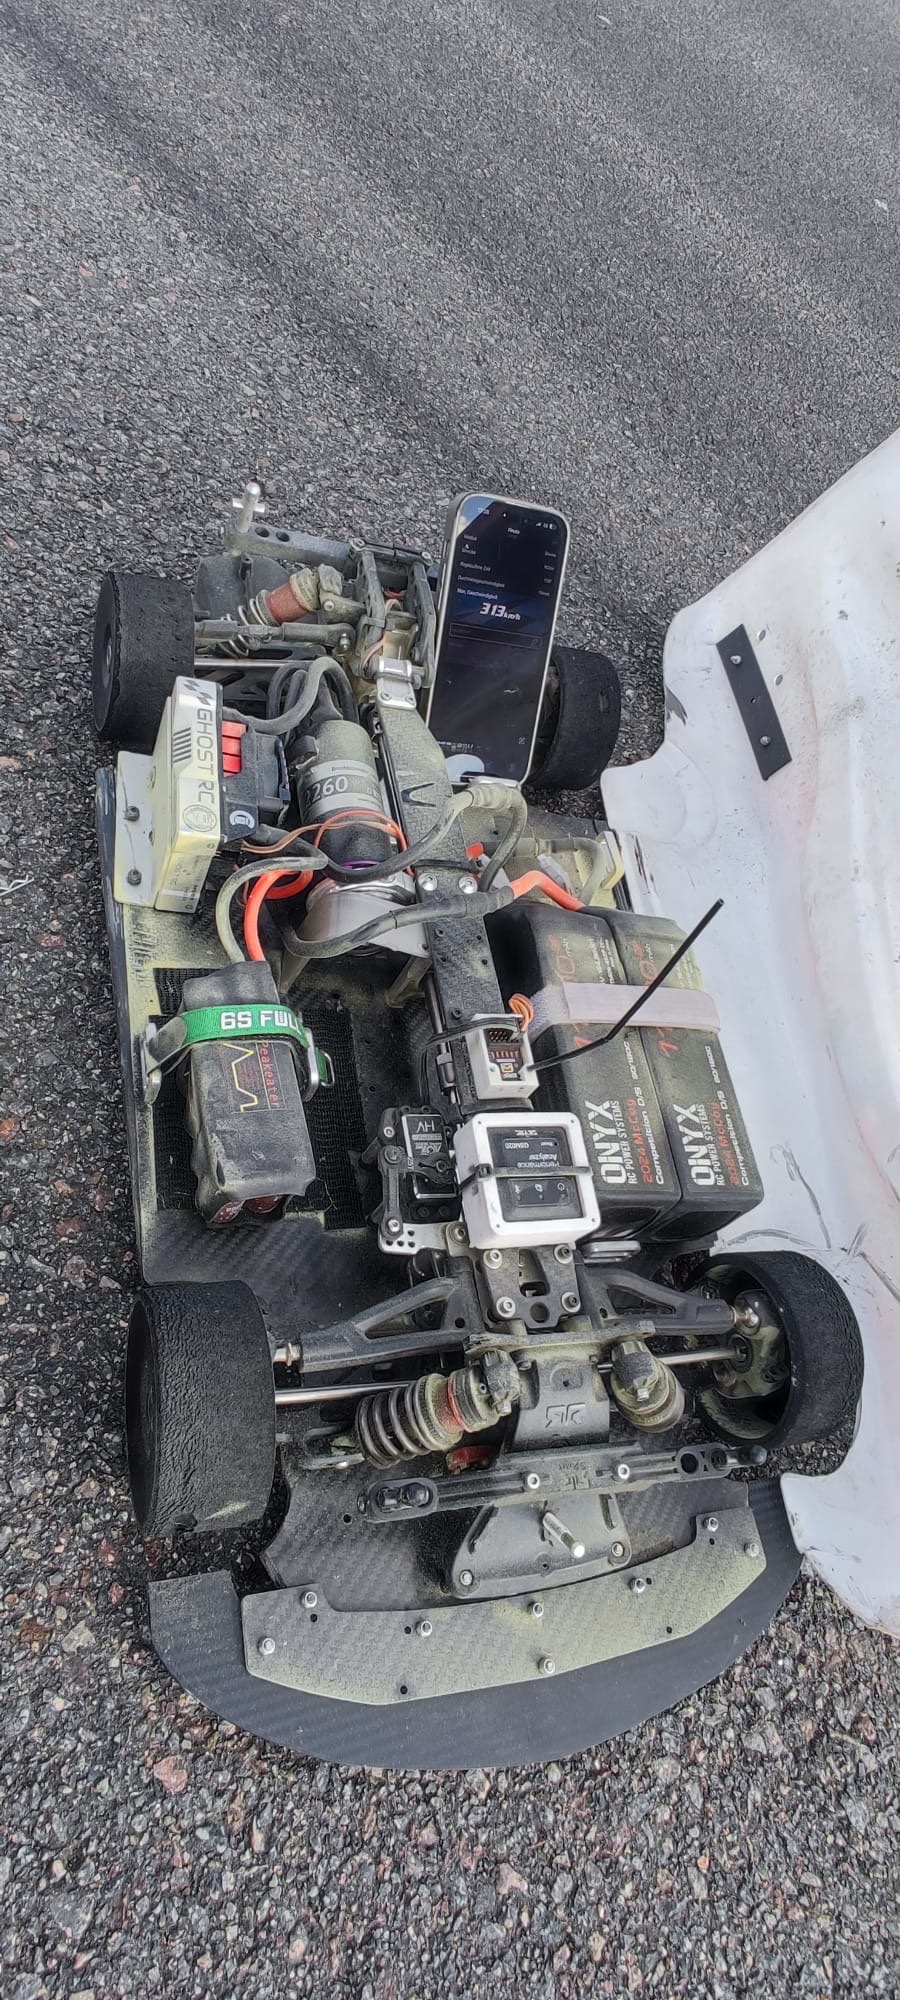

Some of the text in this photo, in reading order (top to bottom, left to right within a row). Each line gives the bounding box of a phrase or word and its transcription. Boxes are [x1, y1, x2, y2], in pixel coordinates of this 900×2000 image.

[197, 708, 214, 804] GHOST RC
[221, 1011, 252, 1030] 6S
[416, 1120, 435, 1132] HV
[585, 1100, 627, 1184] ONYX
[610, 1100, 638, 1185] RC POWER SYSTEMS
[642, 1110, 664, 1185] Competition
[673, 1103, 716, 1186] ONYX
[696, 1104, 726, 1186] RC POWER SYSTEMS
[725, 1113, 750, 1186] Competition
[638, 1148, 653, 1184] 2024
